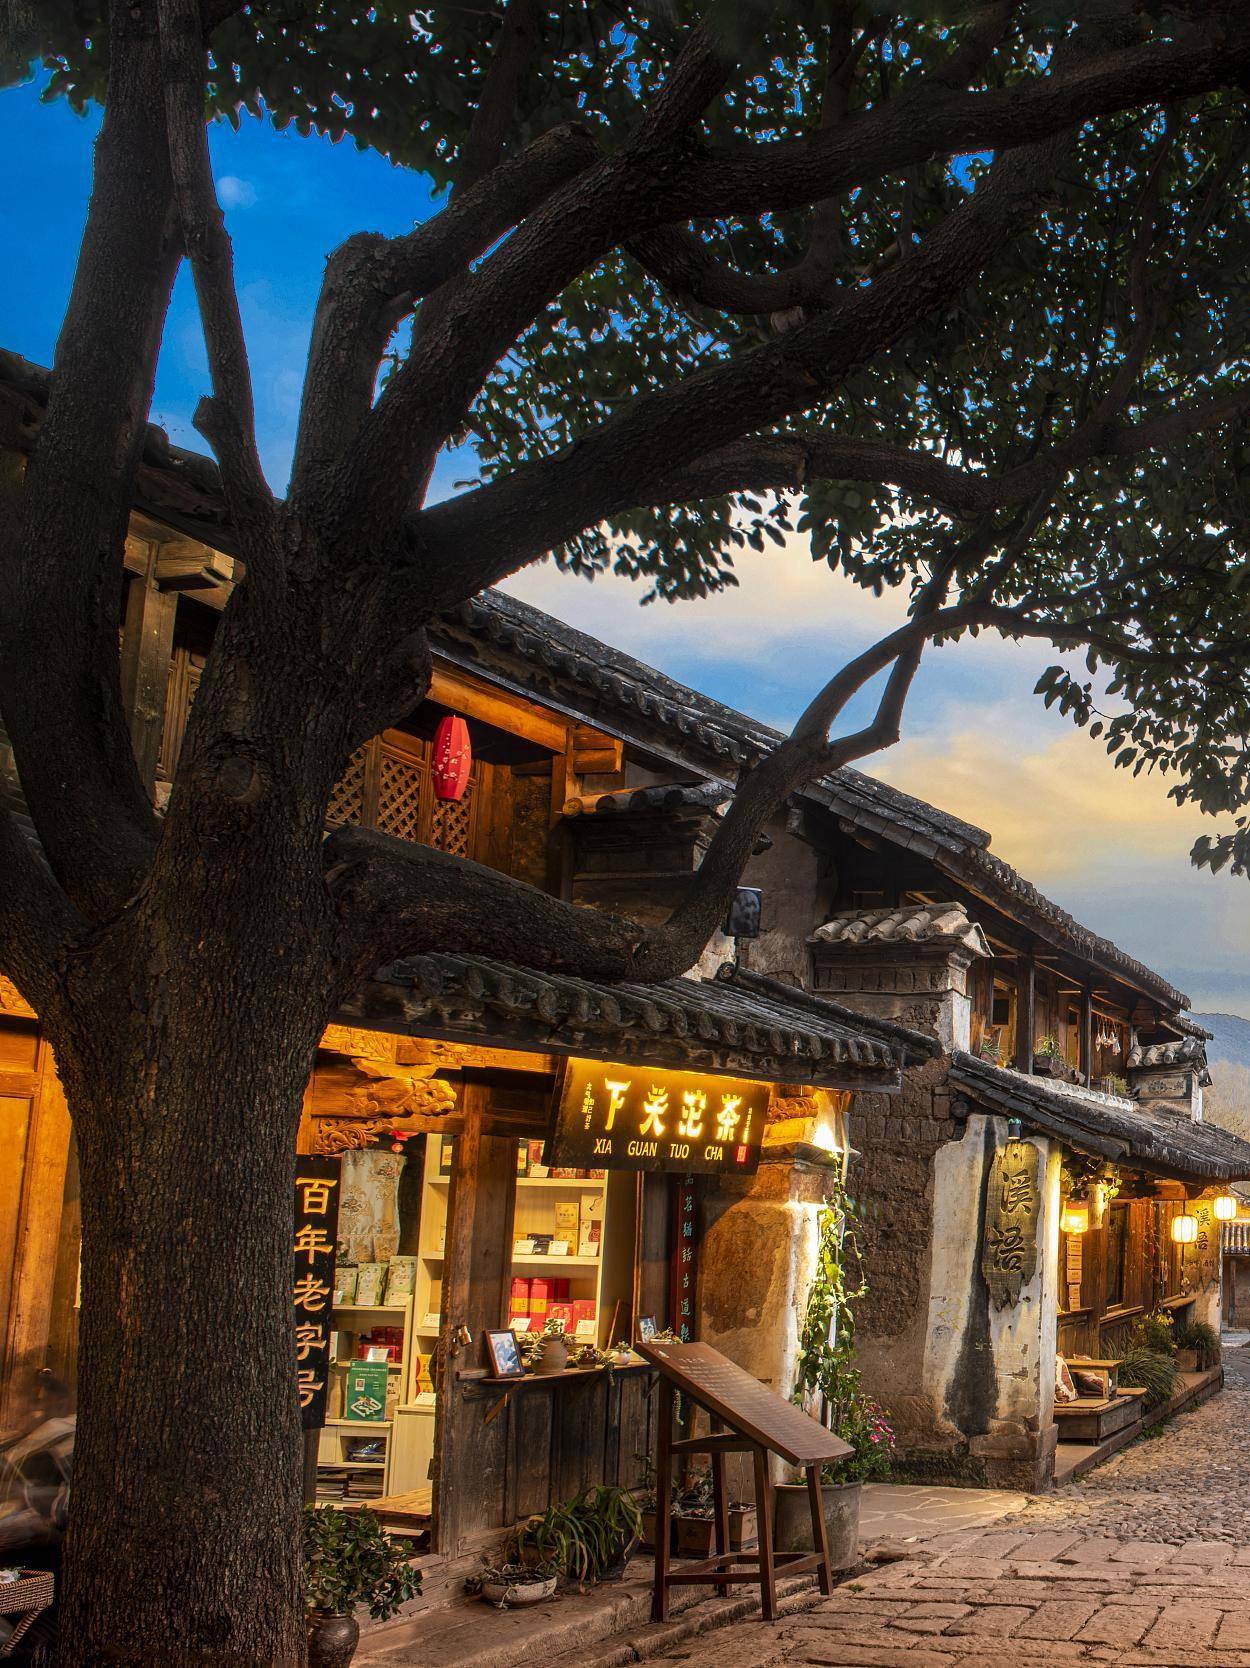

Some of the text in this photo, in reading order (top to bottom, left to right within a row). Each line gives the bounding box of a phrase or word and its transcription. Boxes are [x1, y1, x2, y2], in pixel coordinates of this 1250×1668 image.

[593, 1138, 612, 1155] XIA
[627, 1140, 658, 1157] GUAN
[669, 1143, 690, 1159] TUO
[704, 1145, 723, 1161] CHA
[293, 1177, 338, 1408] 百年老字号
